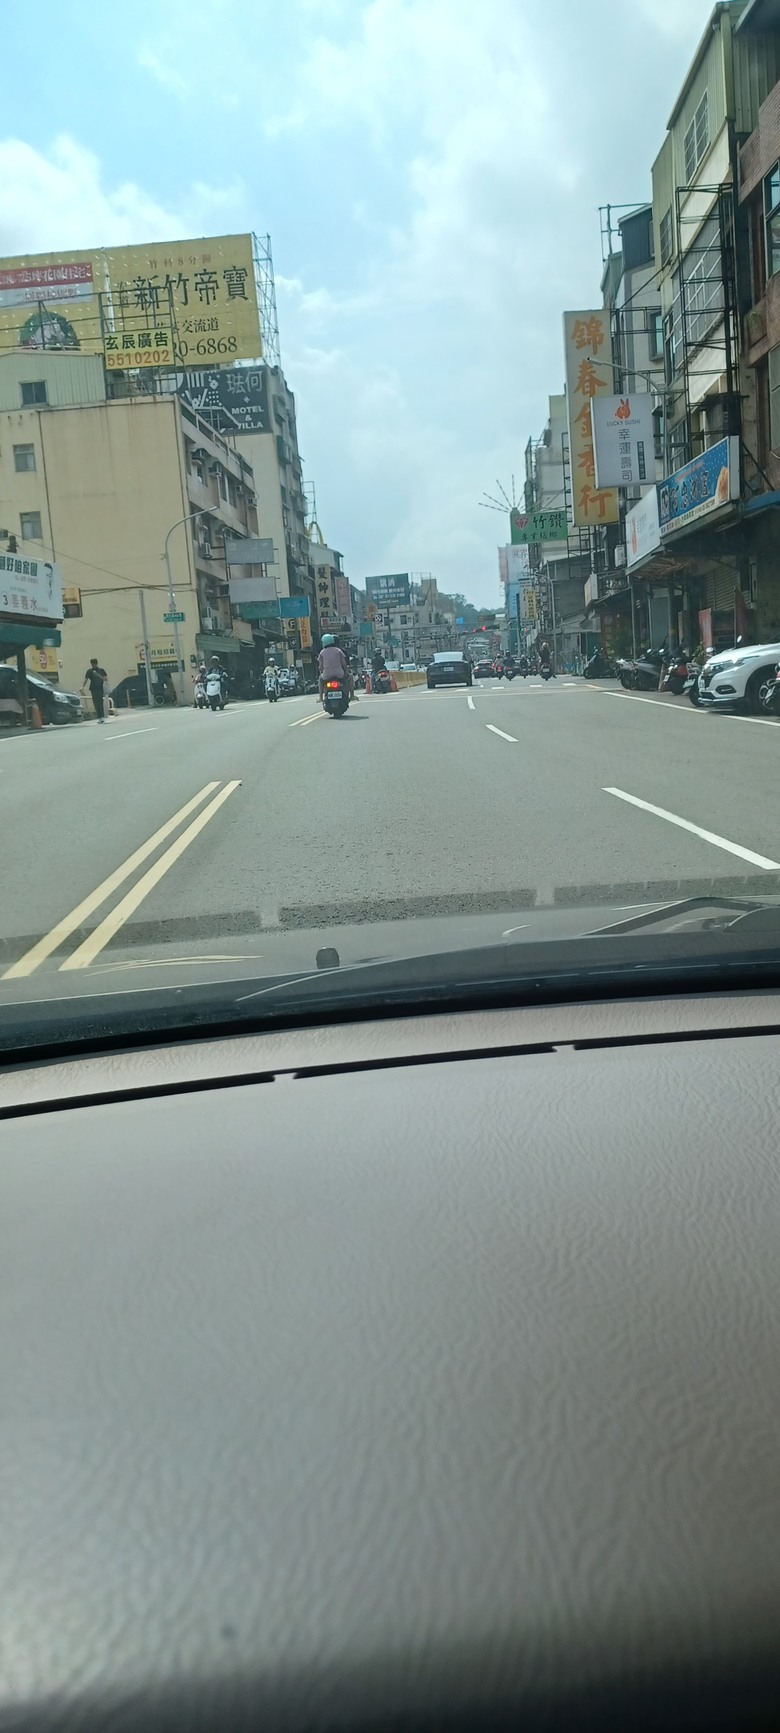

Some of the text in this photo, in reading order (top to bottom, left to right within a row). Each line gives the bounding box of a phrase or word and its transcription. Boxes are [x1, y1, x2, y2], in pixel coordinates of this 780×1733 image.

[132, 265, 248, 311] 新竹帝寶
[104, 331, 168, 350] 玄辰廣告
[107, 349, 170, 367] 5510202
[231, 405, 264, 415] MOTEL
[245, 414, 252, 422] &
[618, 428, 632, 482] 幸運壽司
